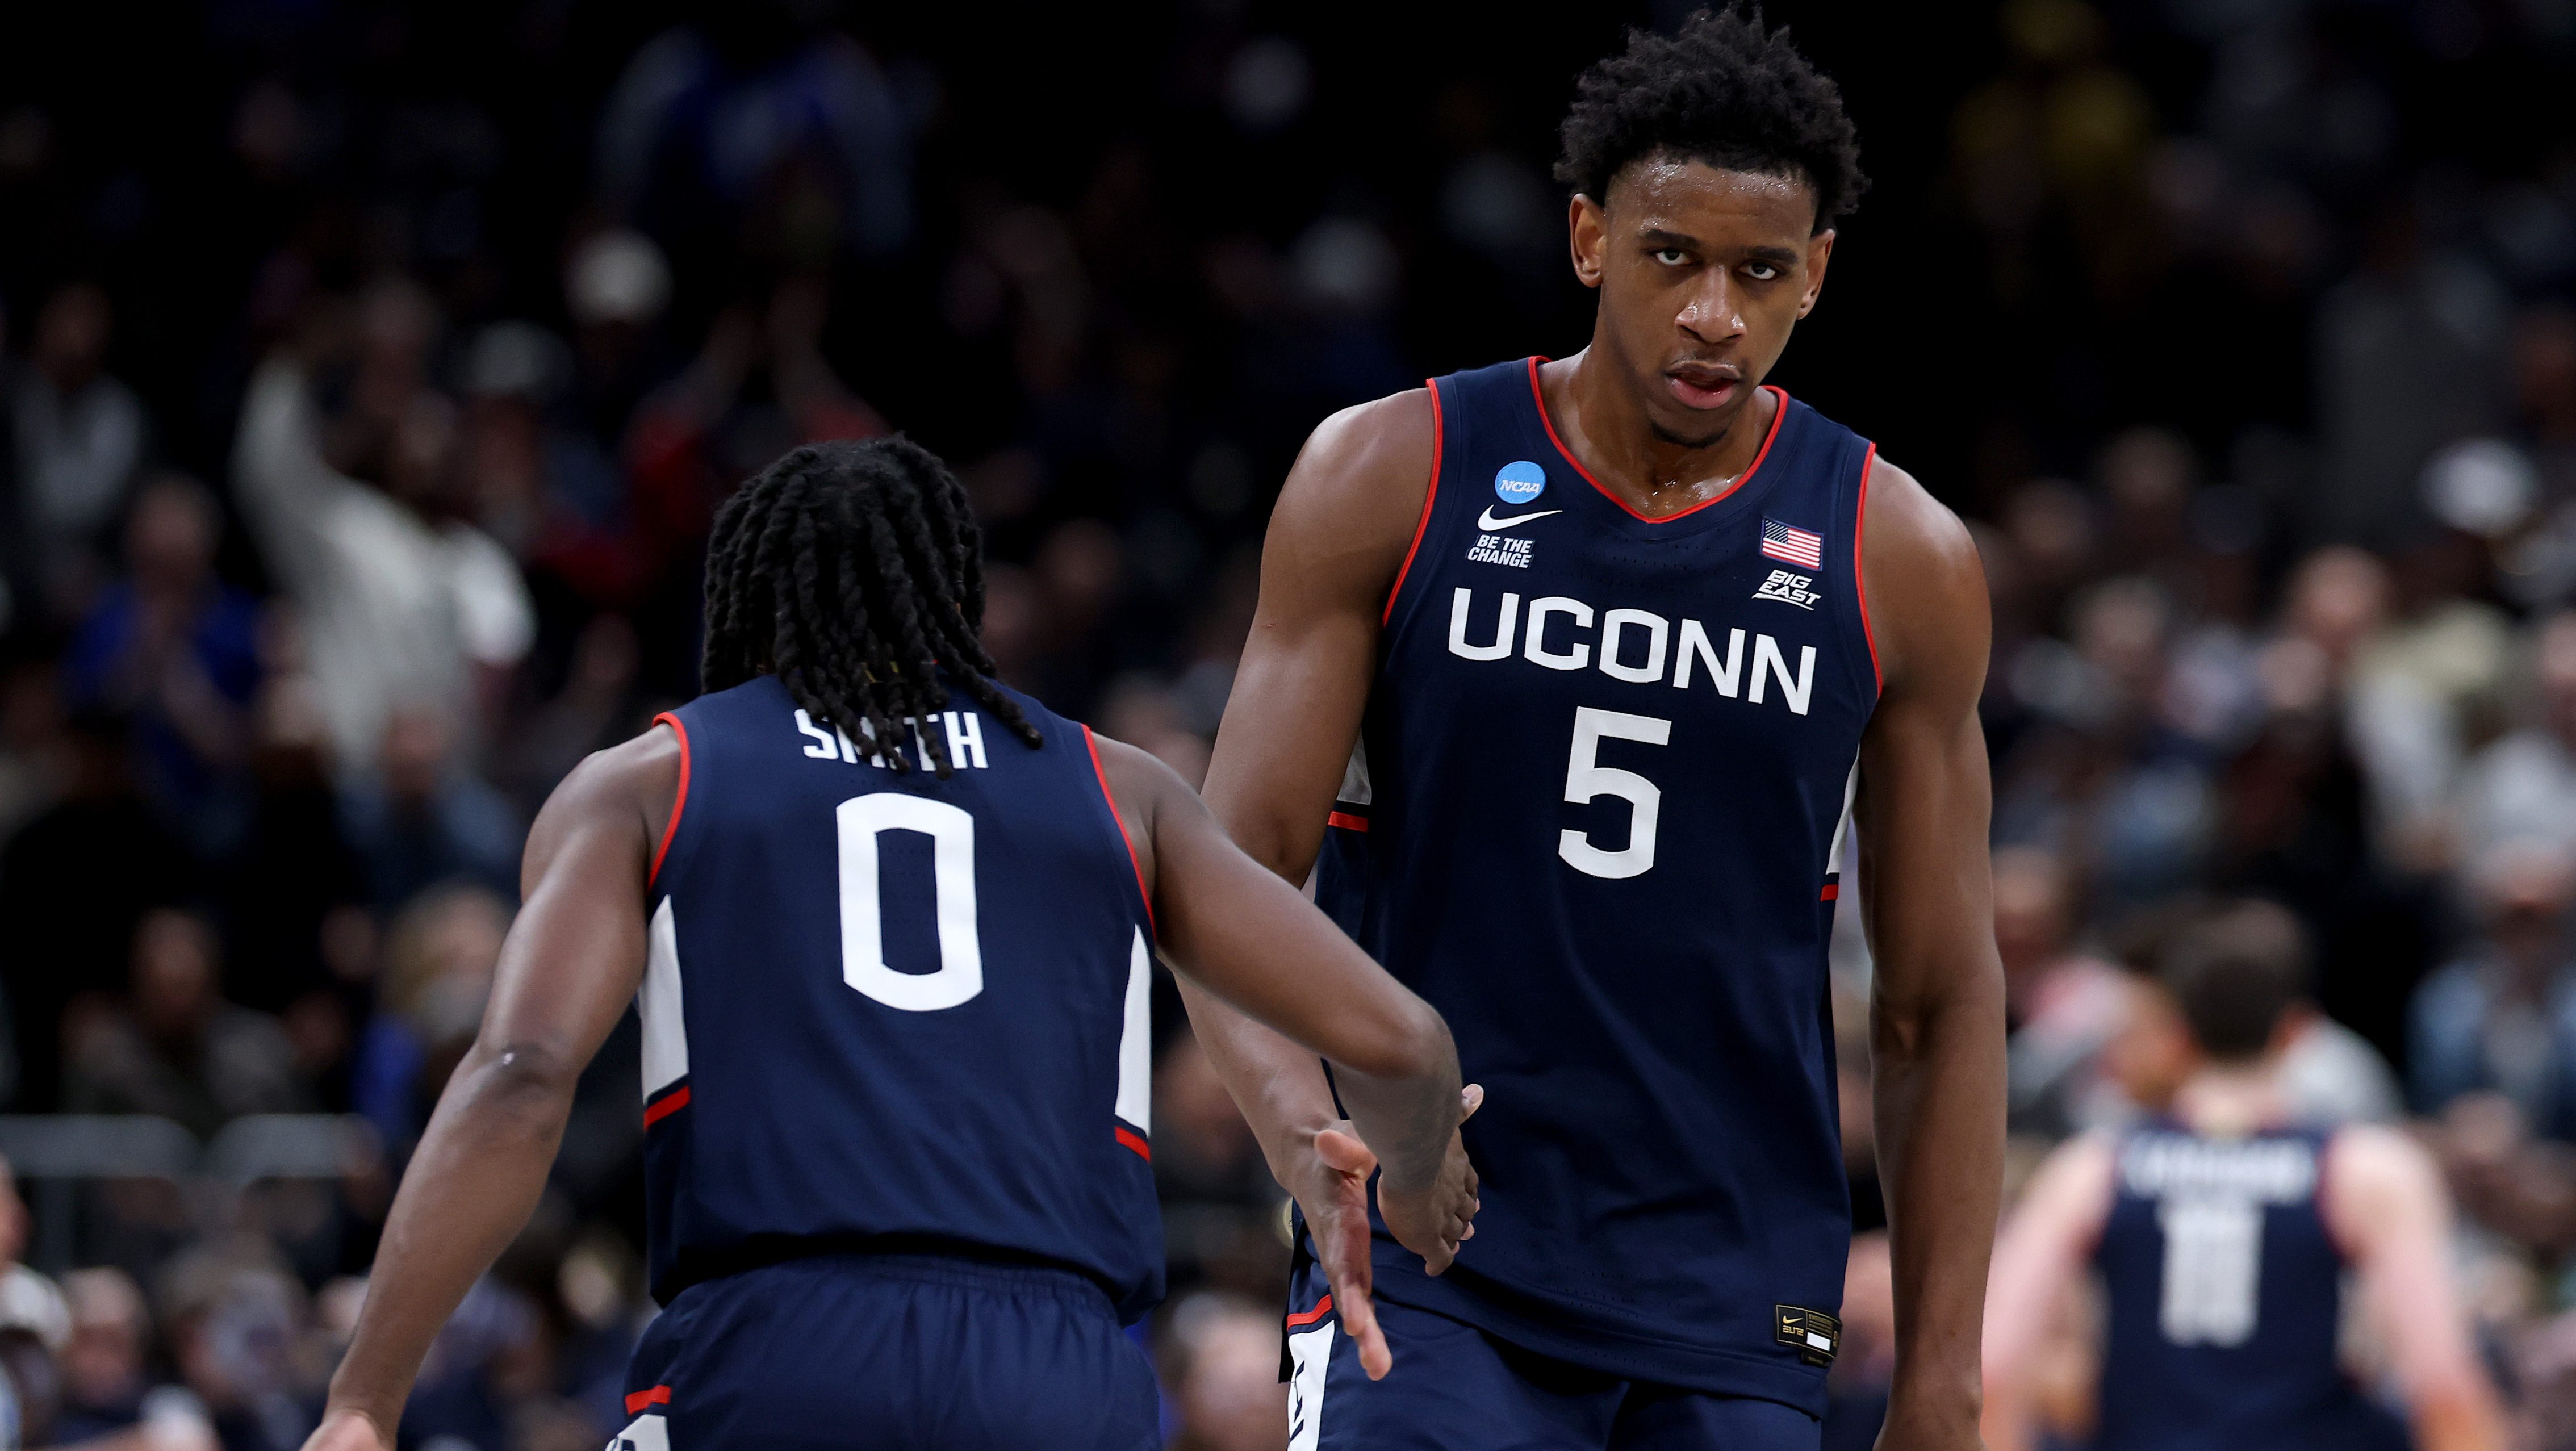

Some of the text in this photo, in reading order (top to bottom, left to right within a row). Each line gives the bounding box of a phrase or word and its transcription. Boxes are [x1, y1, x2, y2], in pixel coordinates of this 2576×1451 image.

[1499, 479, 1541, 494] NCAA
[1477, 534, 1534, 554] BE THE
[1467, 547, 1533, 568] CHANGE
[1766, 568, 1813, 589] BIG
[1758, 580, 1822, 605] EAST
[1448, 587, 1817, 716] UCONN
[794, 708, 990, 772] SMTH
[1558, 705, 1672, 880] 5
[835, 792, 984, 1011] 0
